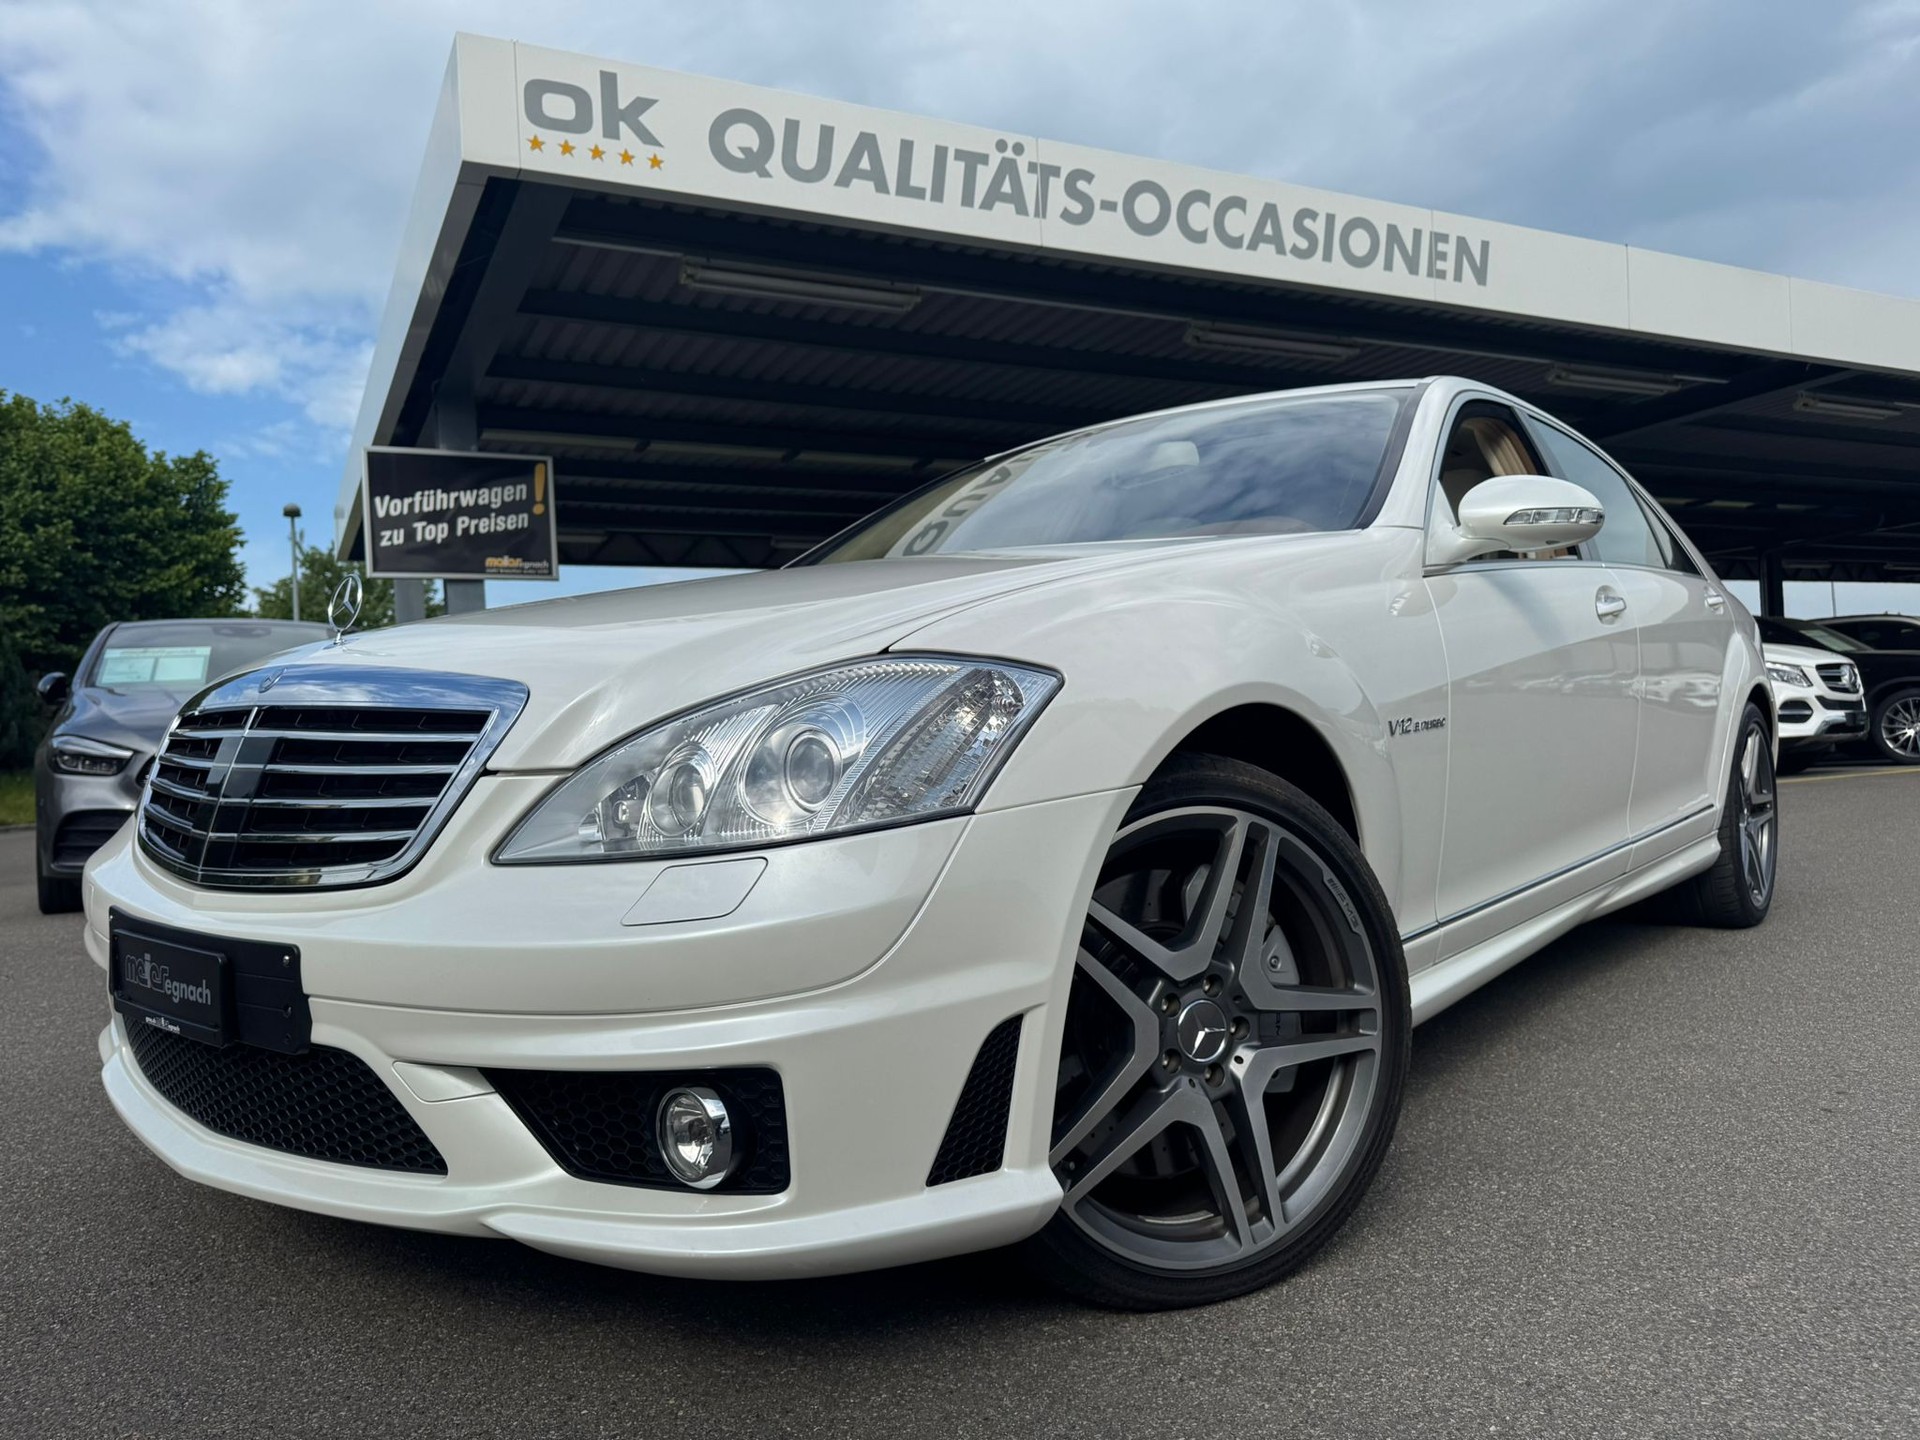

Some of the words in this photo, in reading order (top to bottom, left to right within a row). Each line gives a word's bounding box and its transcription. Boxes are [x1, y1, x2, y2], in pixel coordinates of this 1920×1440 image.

[523, 70, 665, 149] ok
[708, 107, 1491, 287] QUALITÄTS-OCCASIONEN
[374, 483, 528, 519] Vorführwagen
[379, 528, 405, 547] zu
[412, 521, 449, 544] Top
[456, 512, 529, 537] Preisen
[1387, 717, 1412, 737] V12
